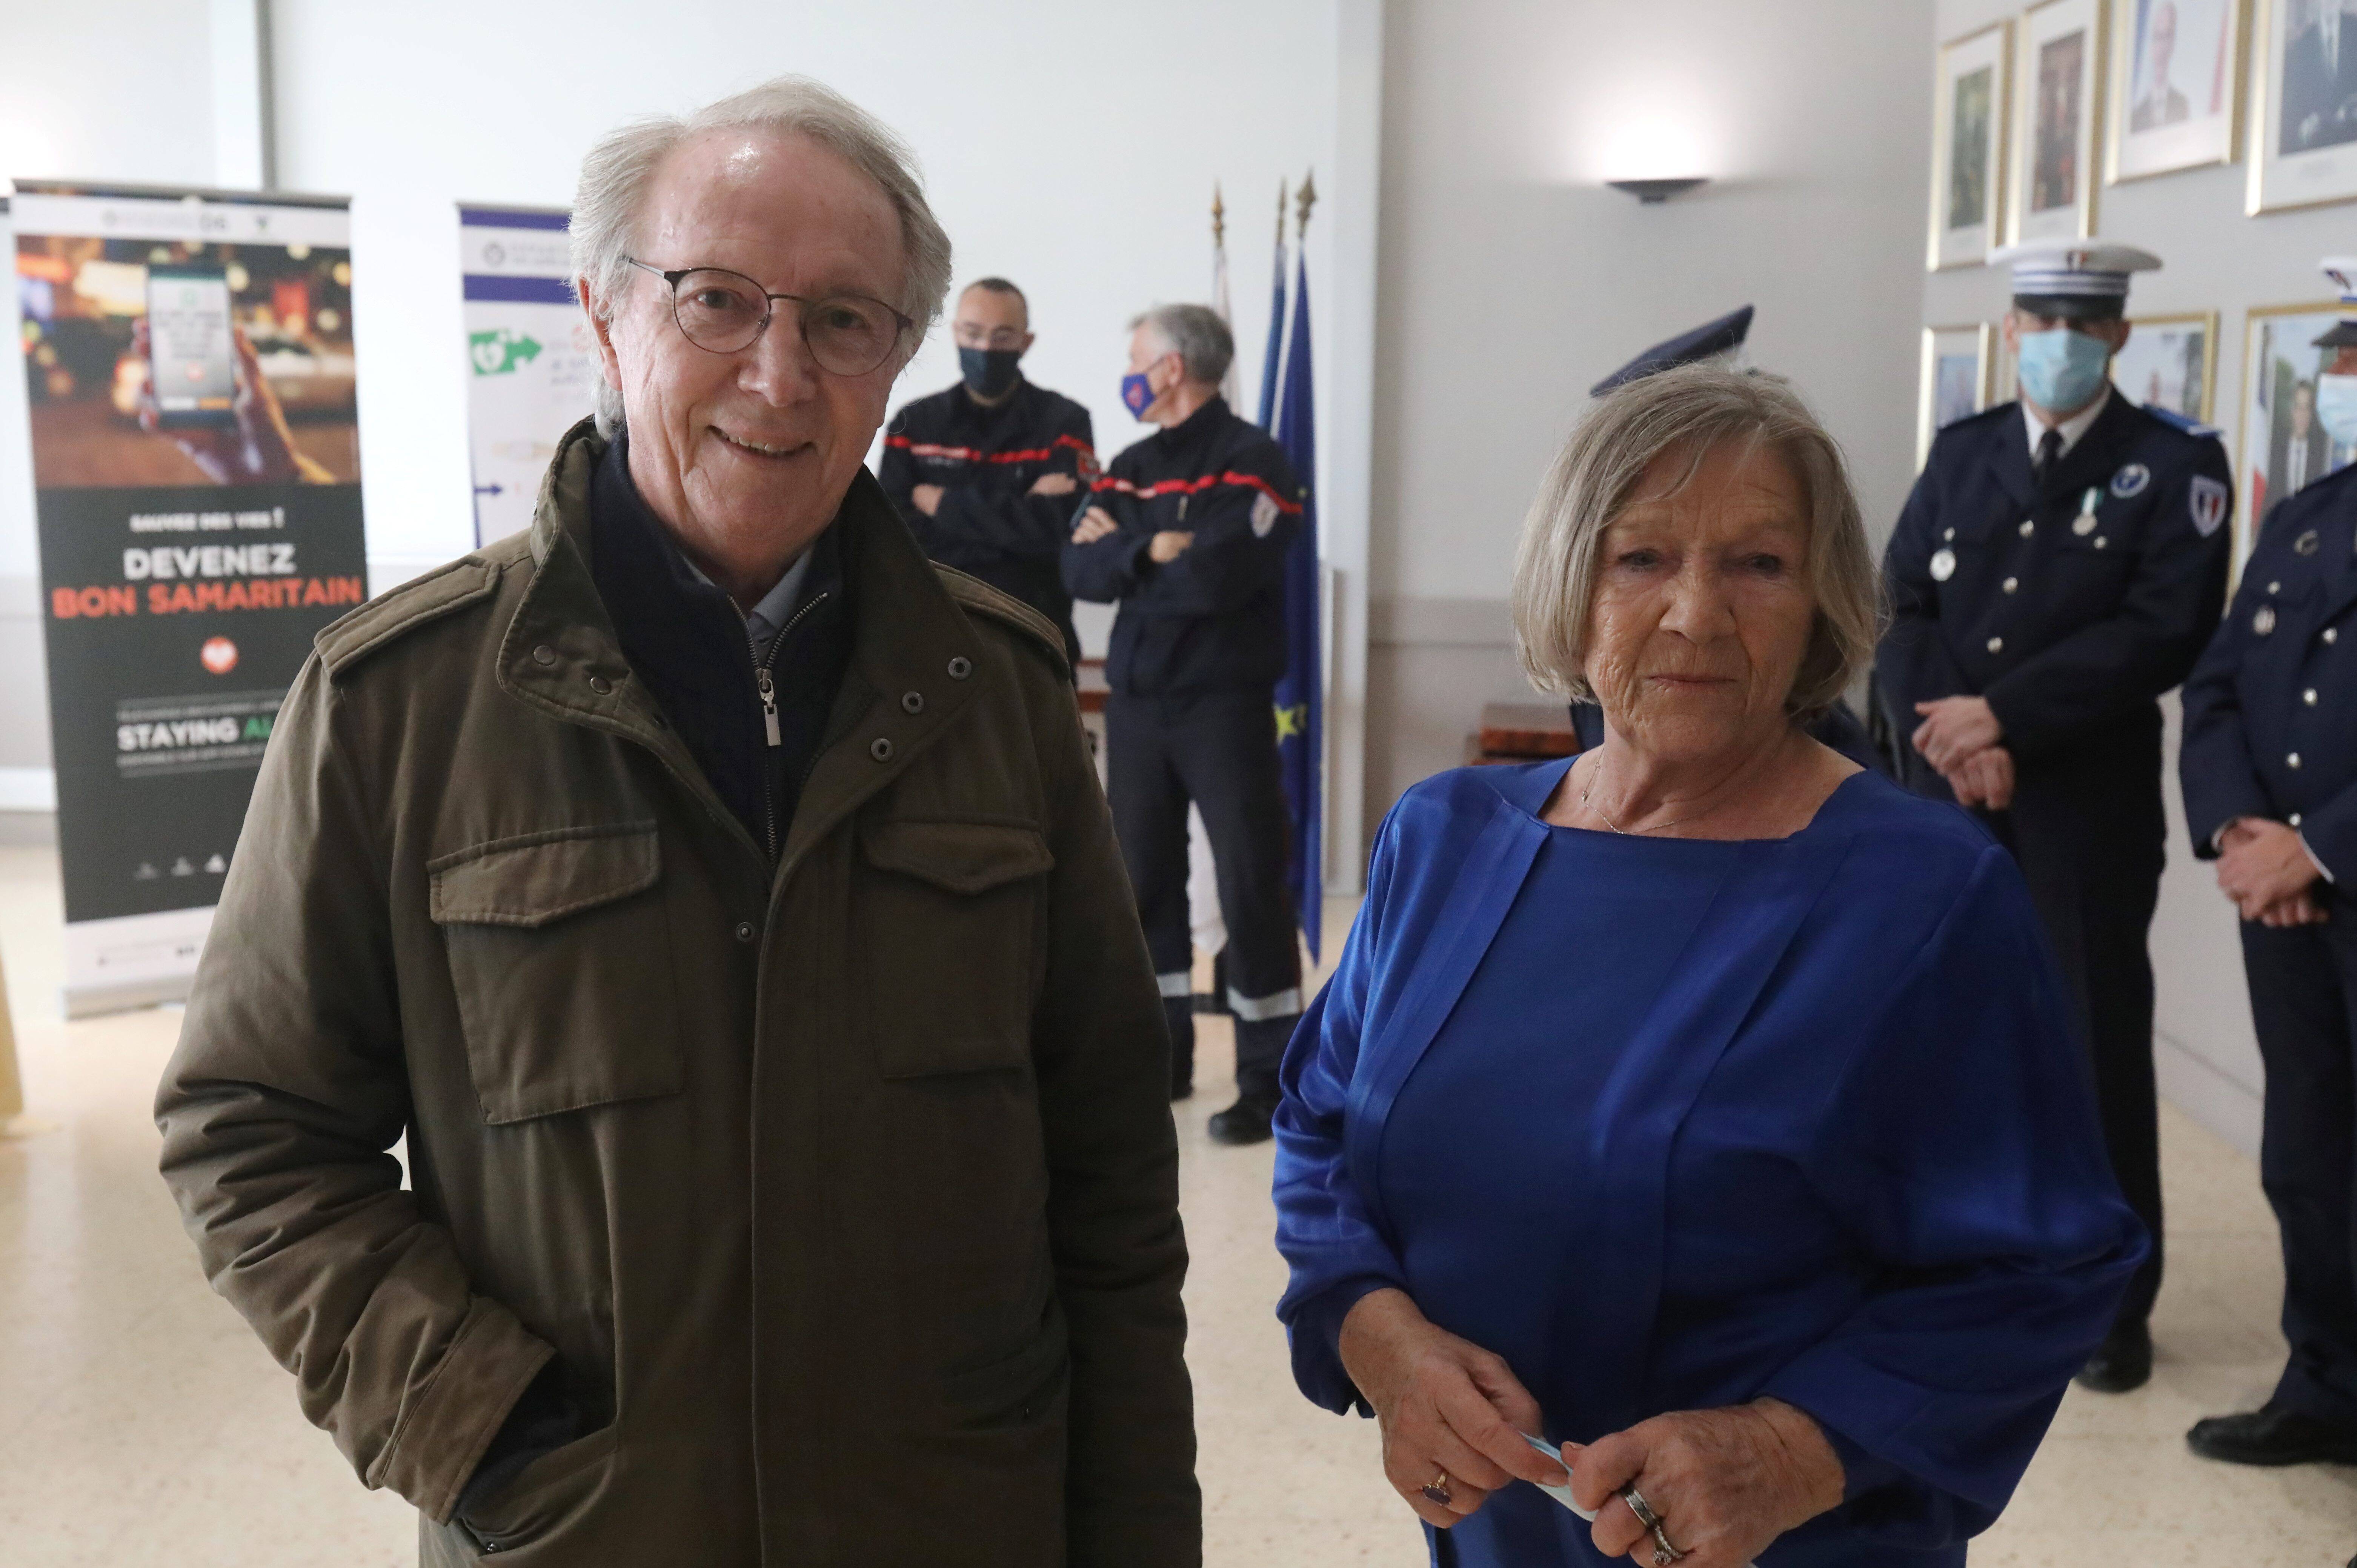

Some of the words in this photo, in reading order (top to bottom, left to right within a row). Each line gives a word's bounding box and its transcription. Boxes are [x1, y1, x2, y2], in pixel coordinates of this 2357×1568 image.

[124, 544, 296, 580] DEVENEZ
[52, 586, 136, 618] BON
[148, 577, 362, 614] SAMARITAIN
[117, 717, 238, 750] STAYING
